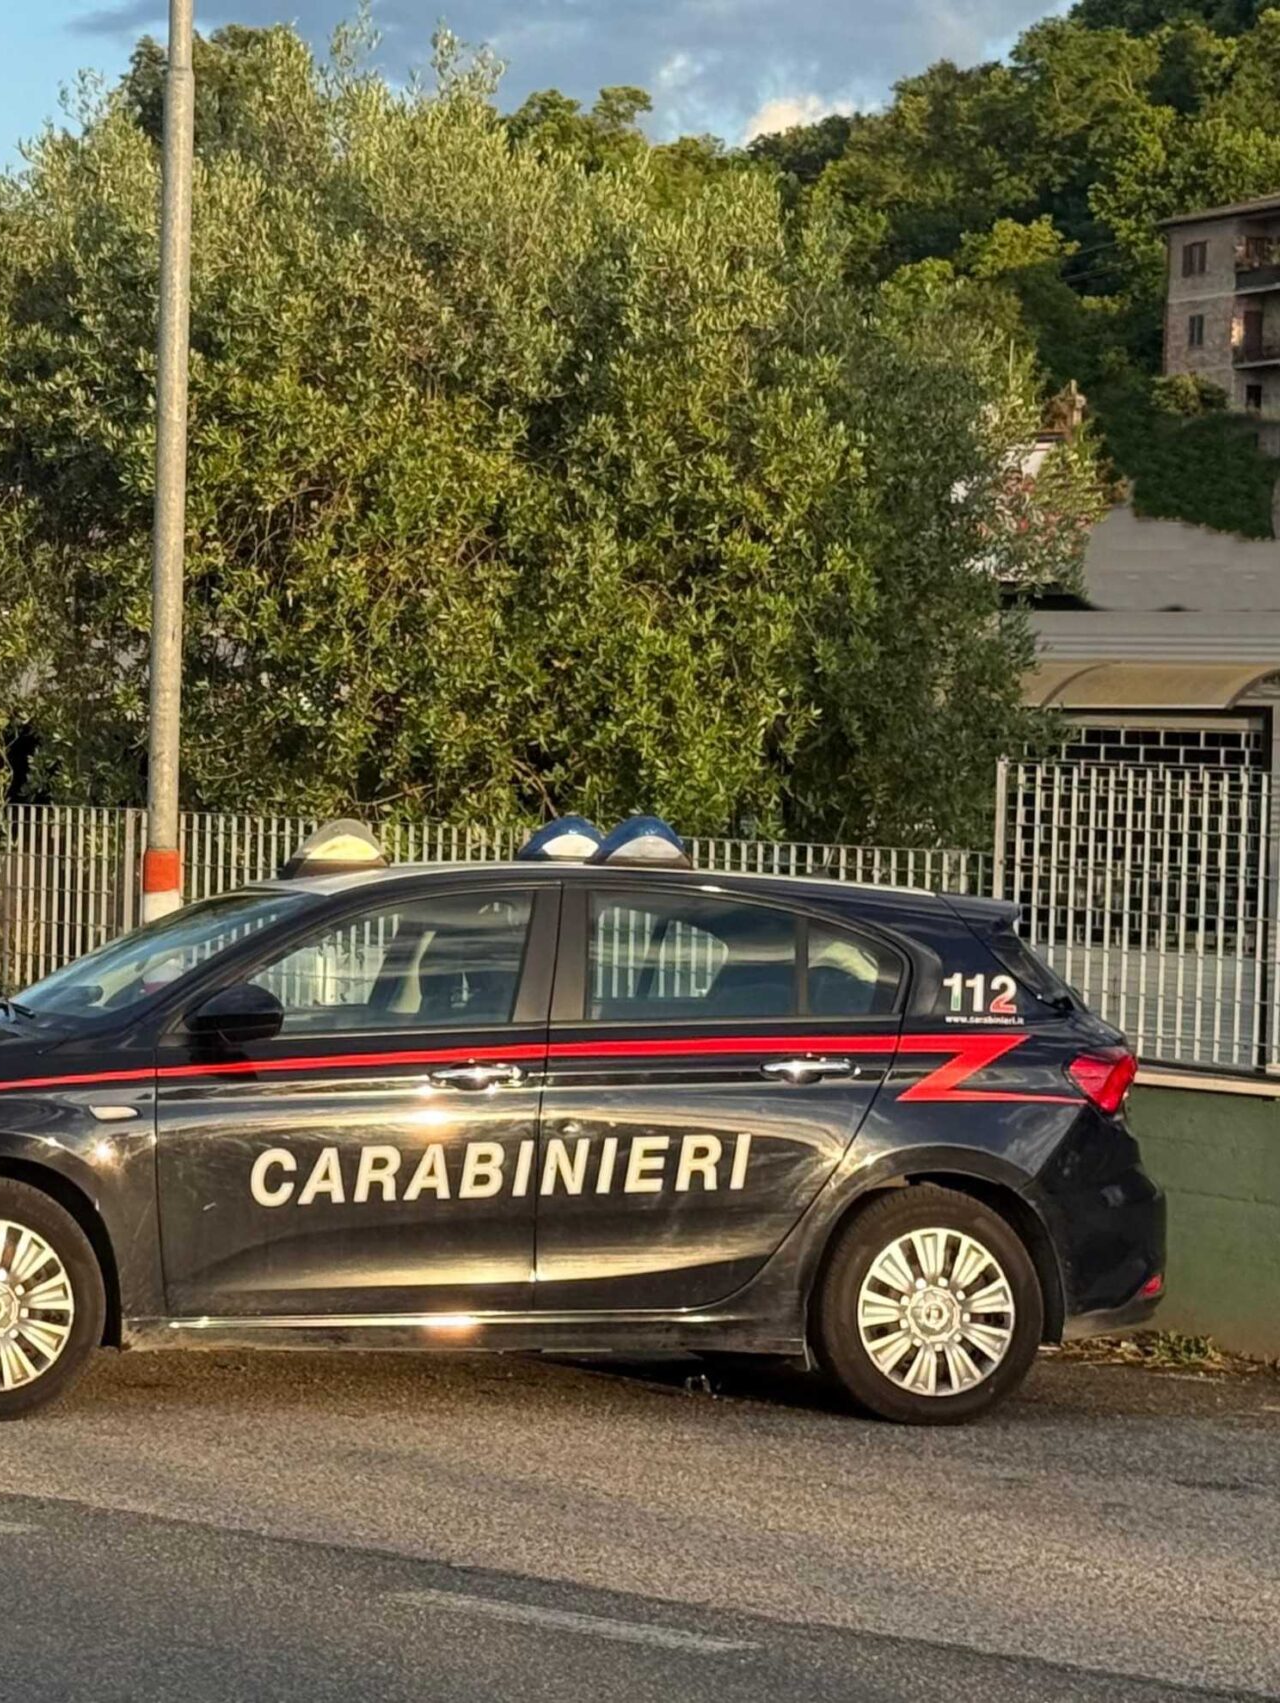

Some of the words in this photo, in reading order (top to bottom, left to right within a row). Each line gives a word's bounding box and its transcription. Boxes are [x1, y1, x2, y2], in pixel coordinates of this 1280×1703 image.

[943, 972, 1018, 1014] 112
[945, 1015, 1025, 1025] www.carabinieri.it
[249, 1133, 751, 1207] CARABINIERI
